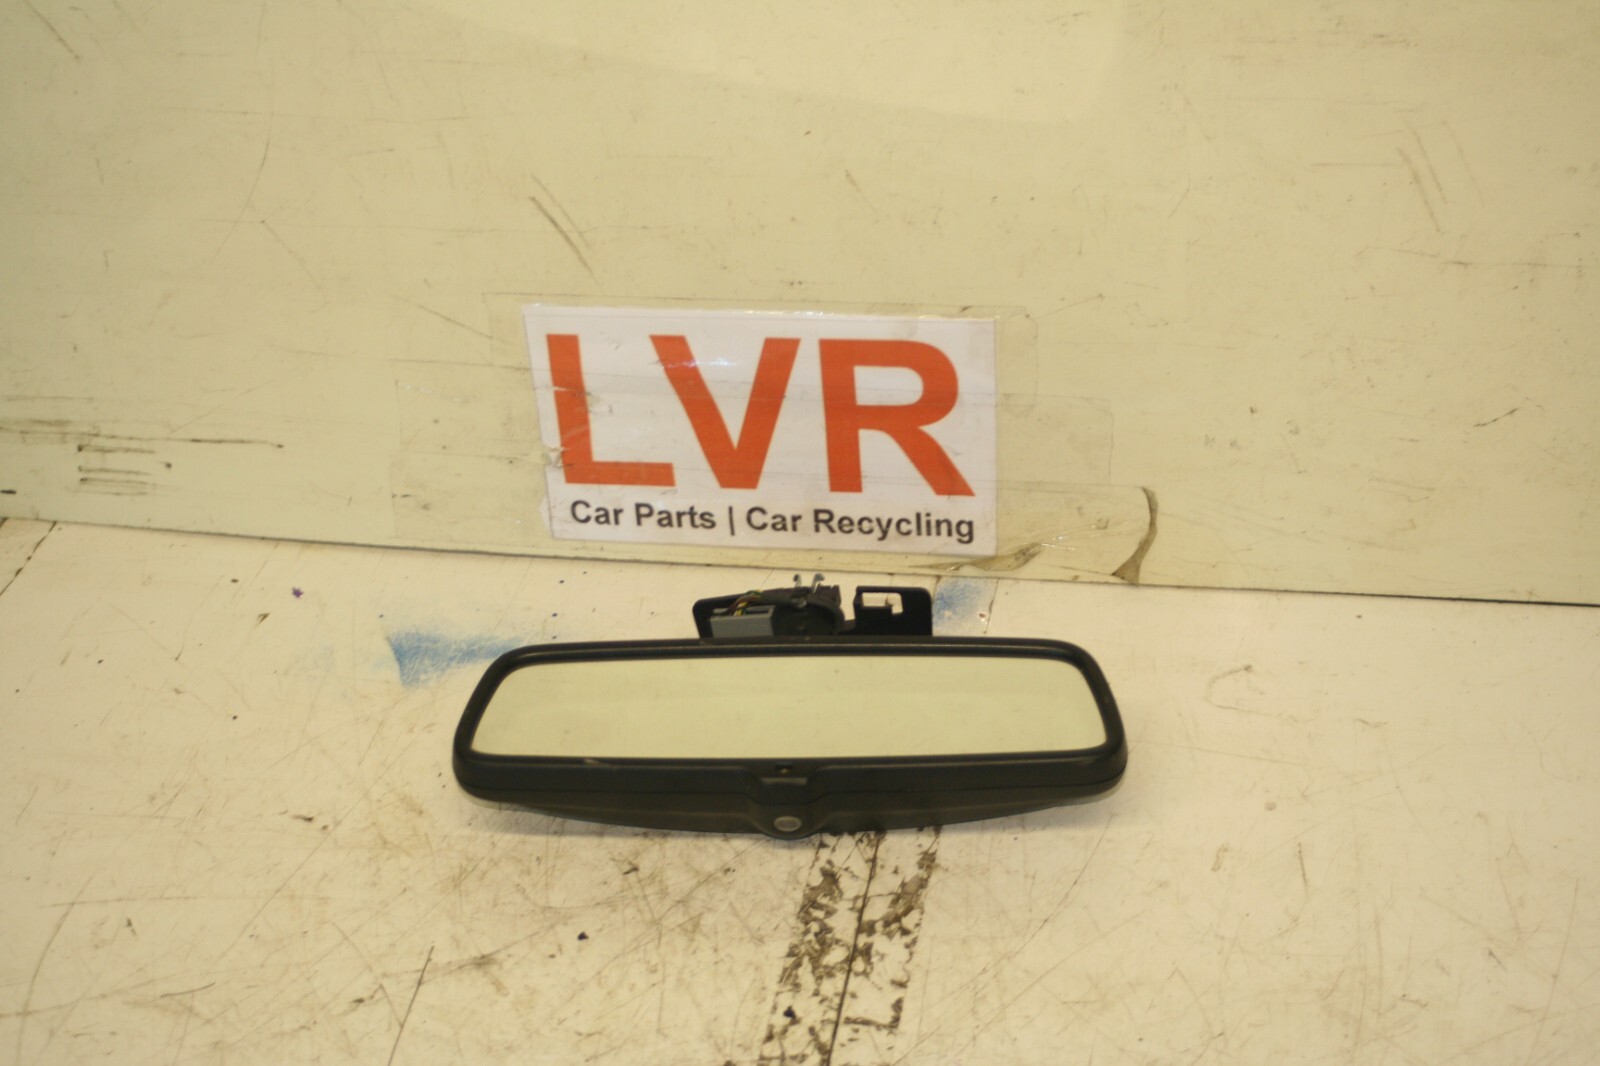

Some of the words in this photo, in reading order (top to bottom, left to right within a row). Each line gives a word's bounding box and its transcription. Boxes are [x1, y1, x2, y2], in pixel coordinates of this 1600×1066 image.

[547, 334, 975, 497] LVR
[571, 500, 623, 526] Car
[635, 503, 717, 530] Parts
[746, 506, 802, 533] Car
[813, 508, 975, 545] Recycling
